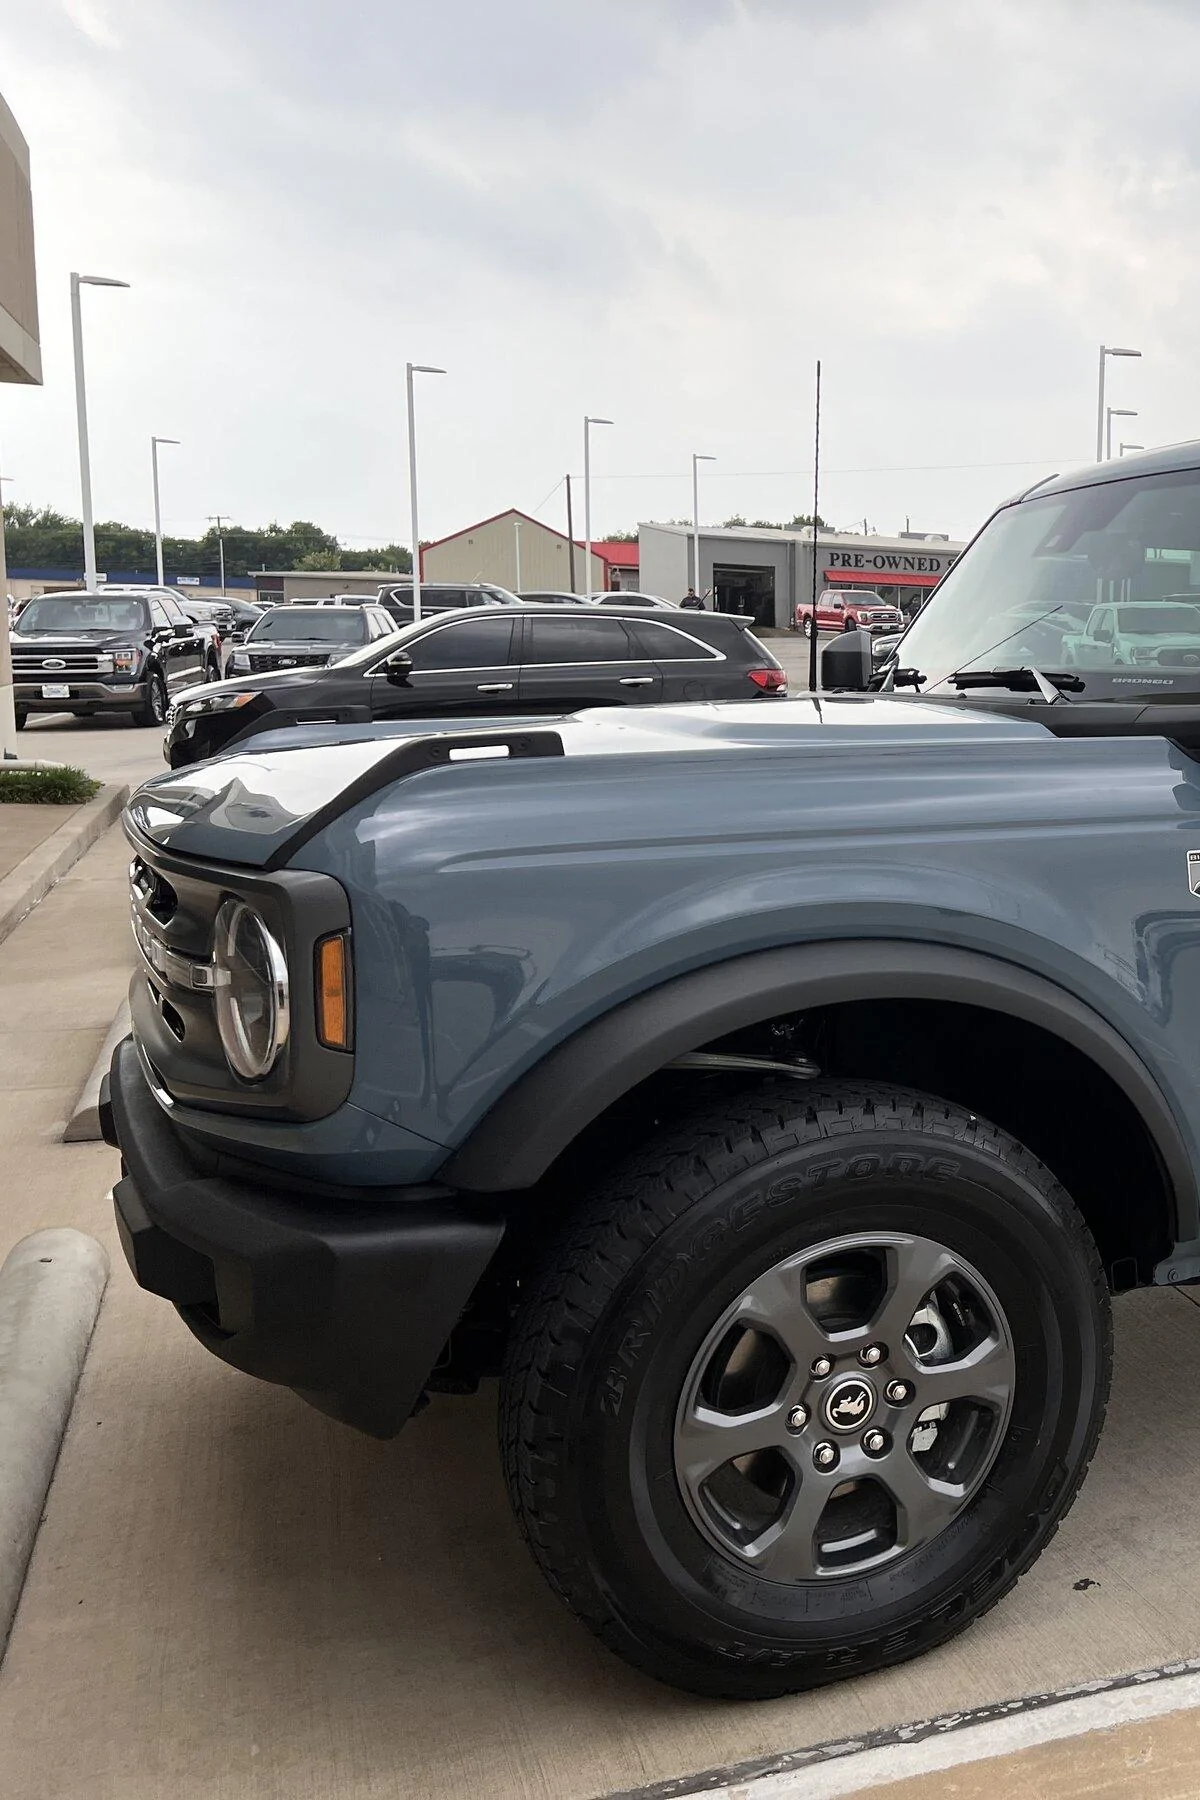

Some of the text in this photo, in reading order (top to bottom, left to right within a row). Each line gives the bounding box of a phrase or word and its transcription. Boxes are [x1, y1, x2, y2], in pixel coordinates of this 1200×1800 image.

[829, 552, 941, 572] PRE-OWNED
[1112, 677, 1174, 685] BRONCO
[601, 1152, 962, 1421] BRIDGESTONE
